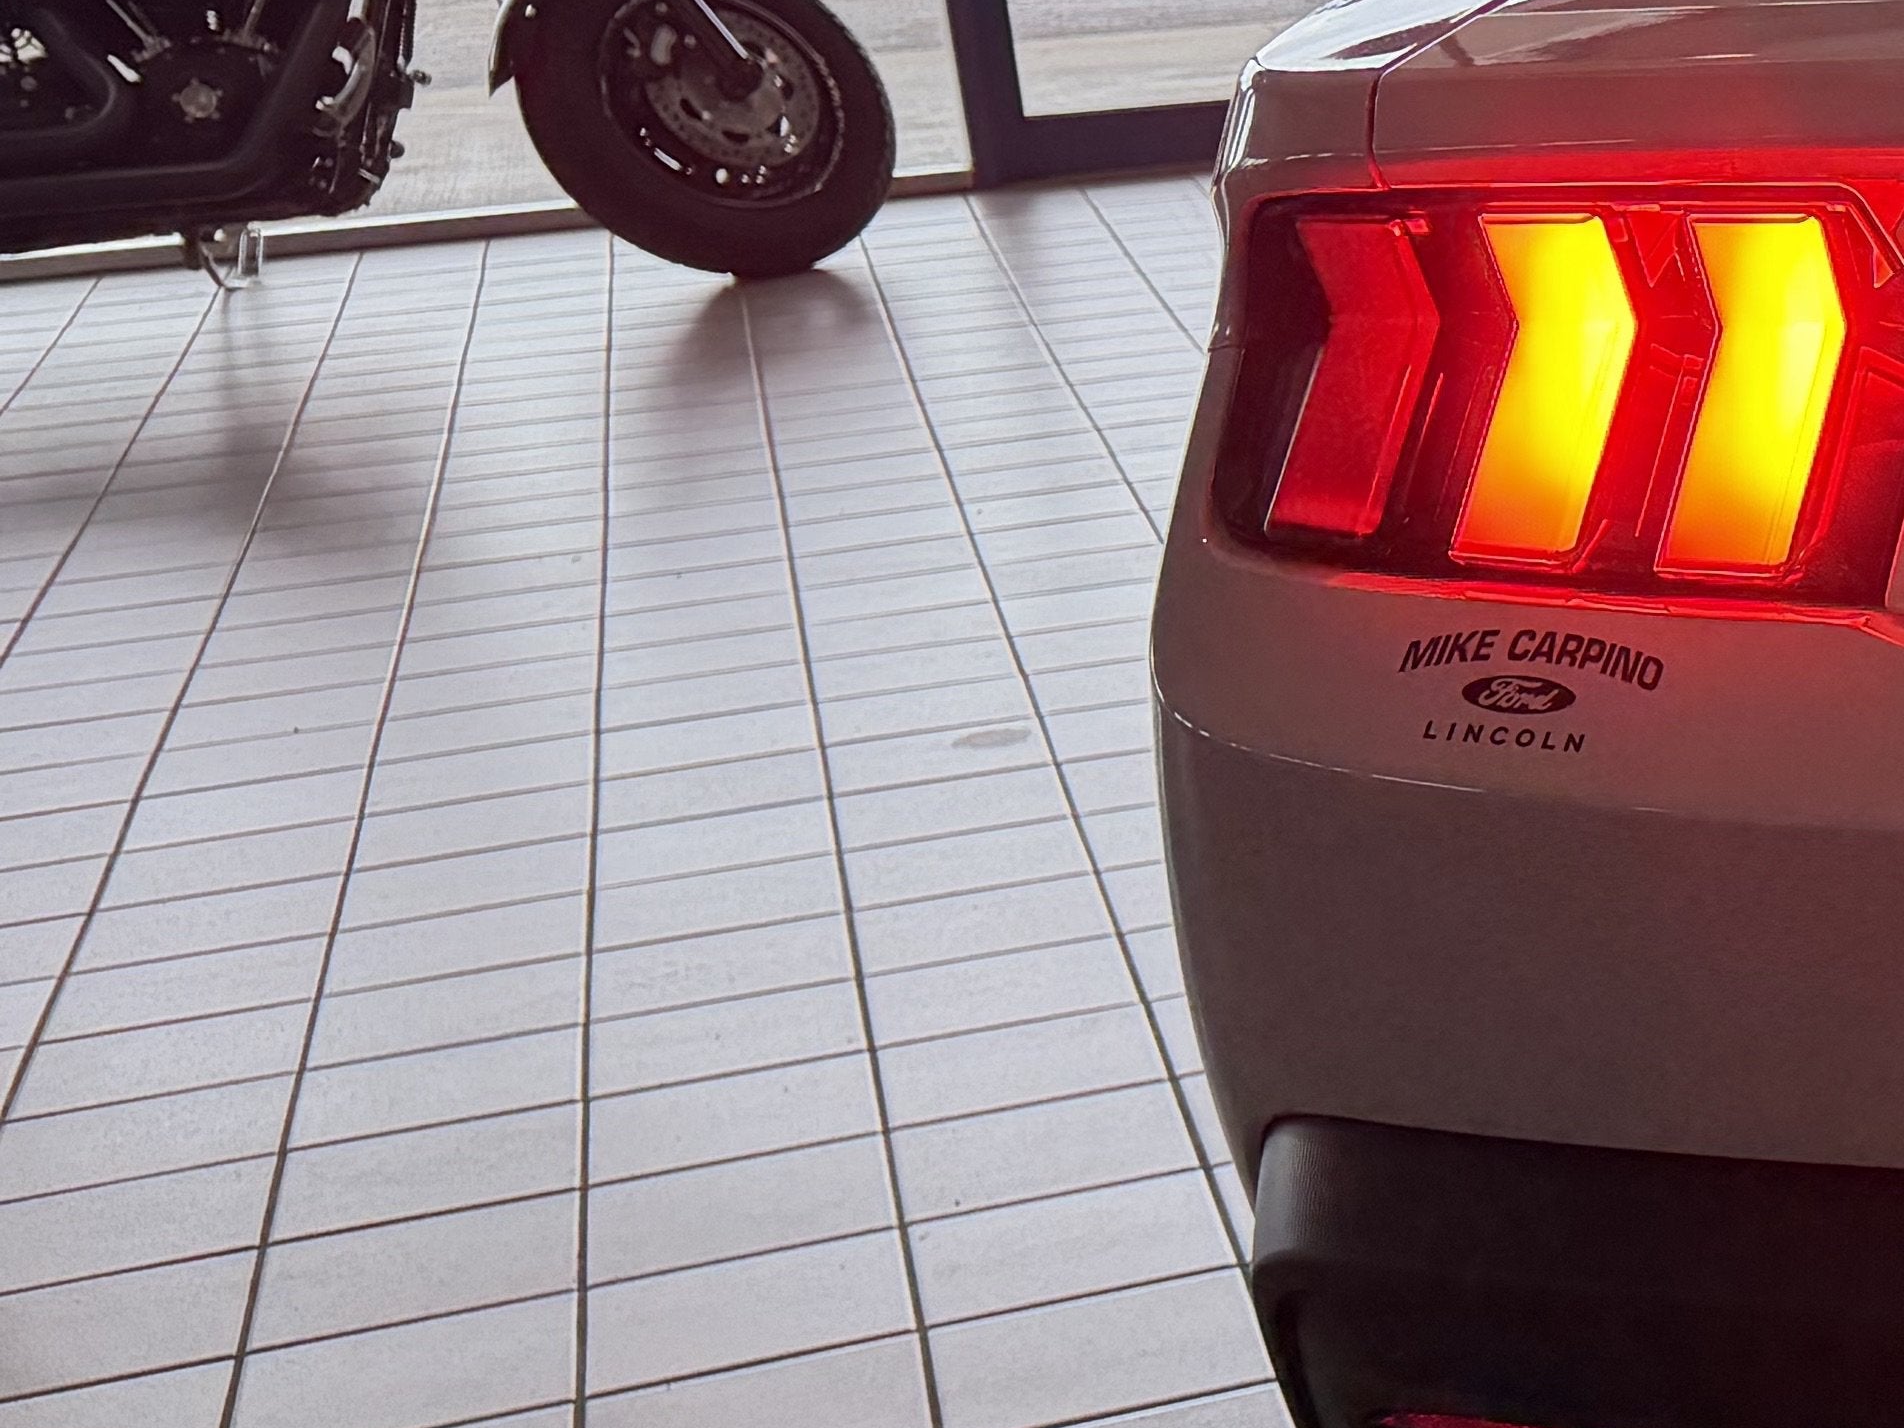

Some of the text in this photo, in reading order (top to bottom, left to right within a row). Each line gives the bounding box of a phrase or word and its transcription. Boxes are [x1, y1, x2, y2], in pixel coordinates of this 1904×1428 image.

[1399, 629, 1664, 691] MIKE CARPINO
[1478, 677, 1560, 711] Ford
[1423, 721, 1585, 753] LINCOLN
